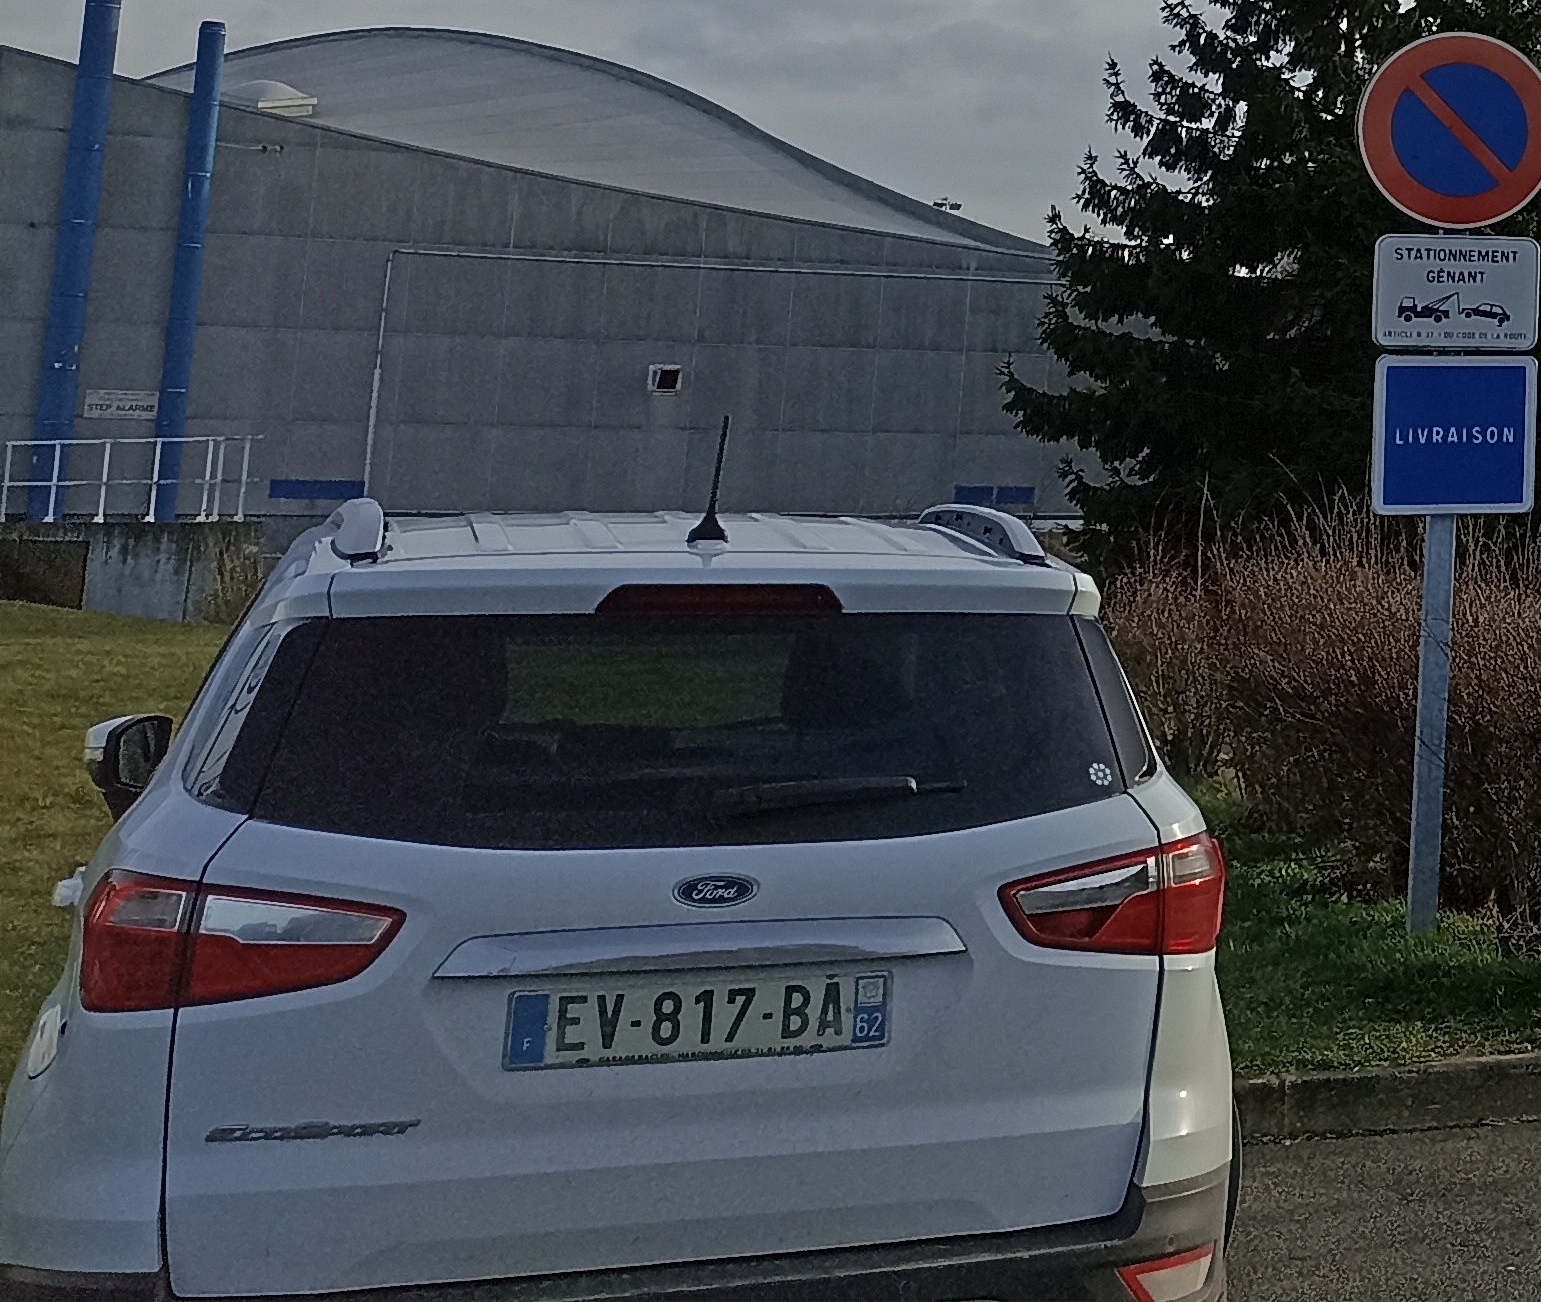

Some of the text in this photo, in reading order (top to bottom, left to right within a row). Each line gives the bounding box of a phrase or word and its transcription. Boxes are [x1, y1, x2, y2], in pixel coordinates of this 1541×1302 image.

[1394, 247, 1518, 264] STATIONNEMENT
[1426, 267, 1486, 284] GÊNANT
[1395, 426, 1515, 445] LIVRAISON
[691, 880, 740, 900] Ford
[555, 982, 844, 1052] EV-817-BA
[855, 1012, 883, 1037] 62
[523, 1038, 532, 1051] F
